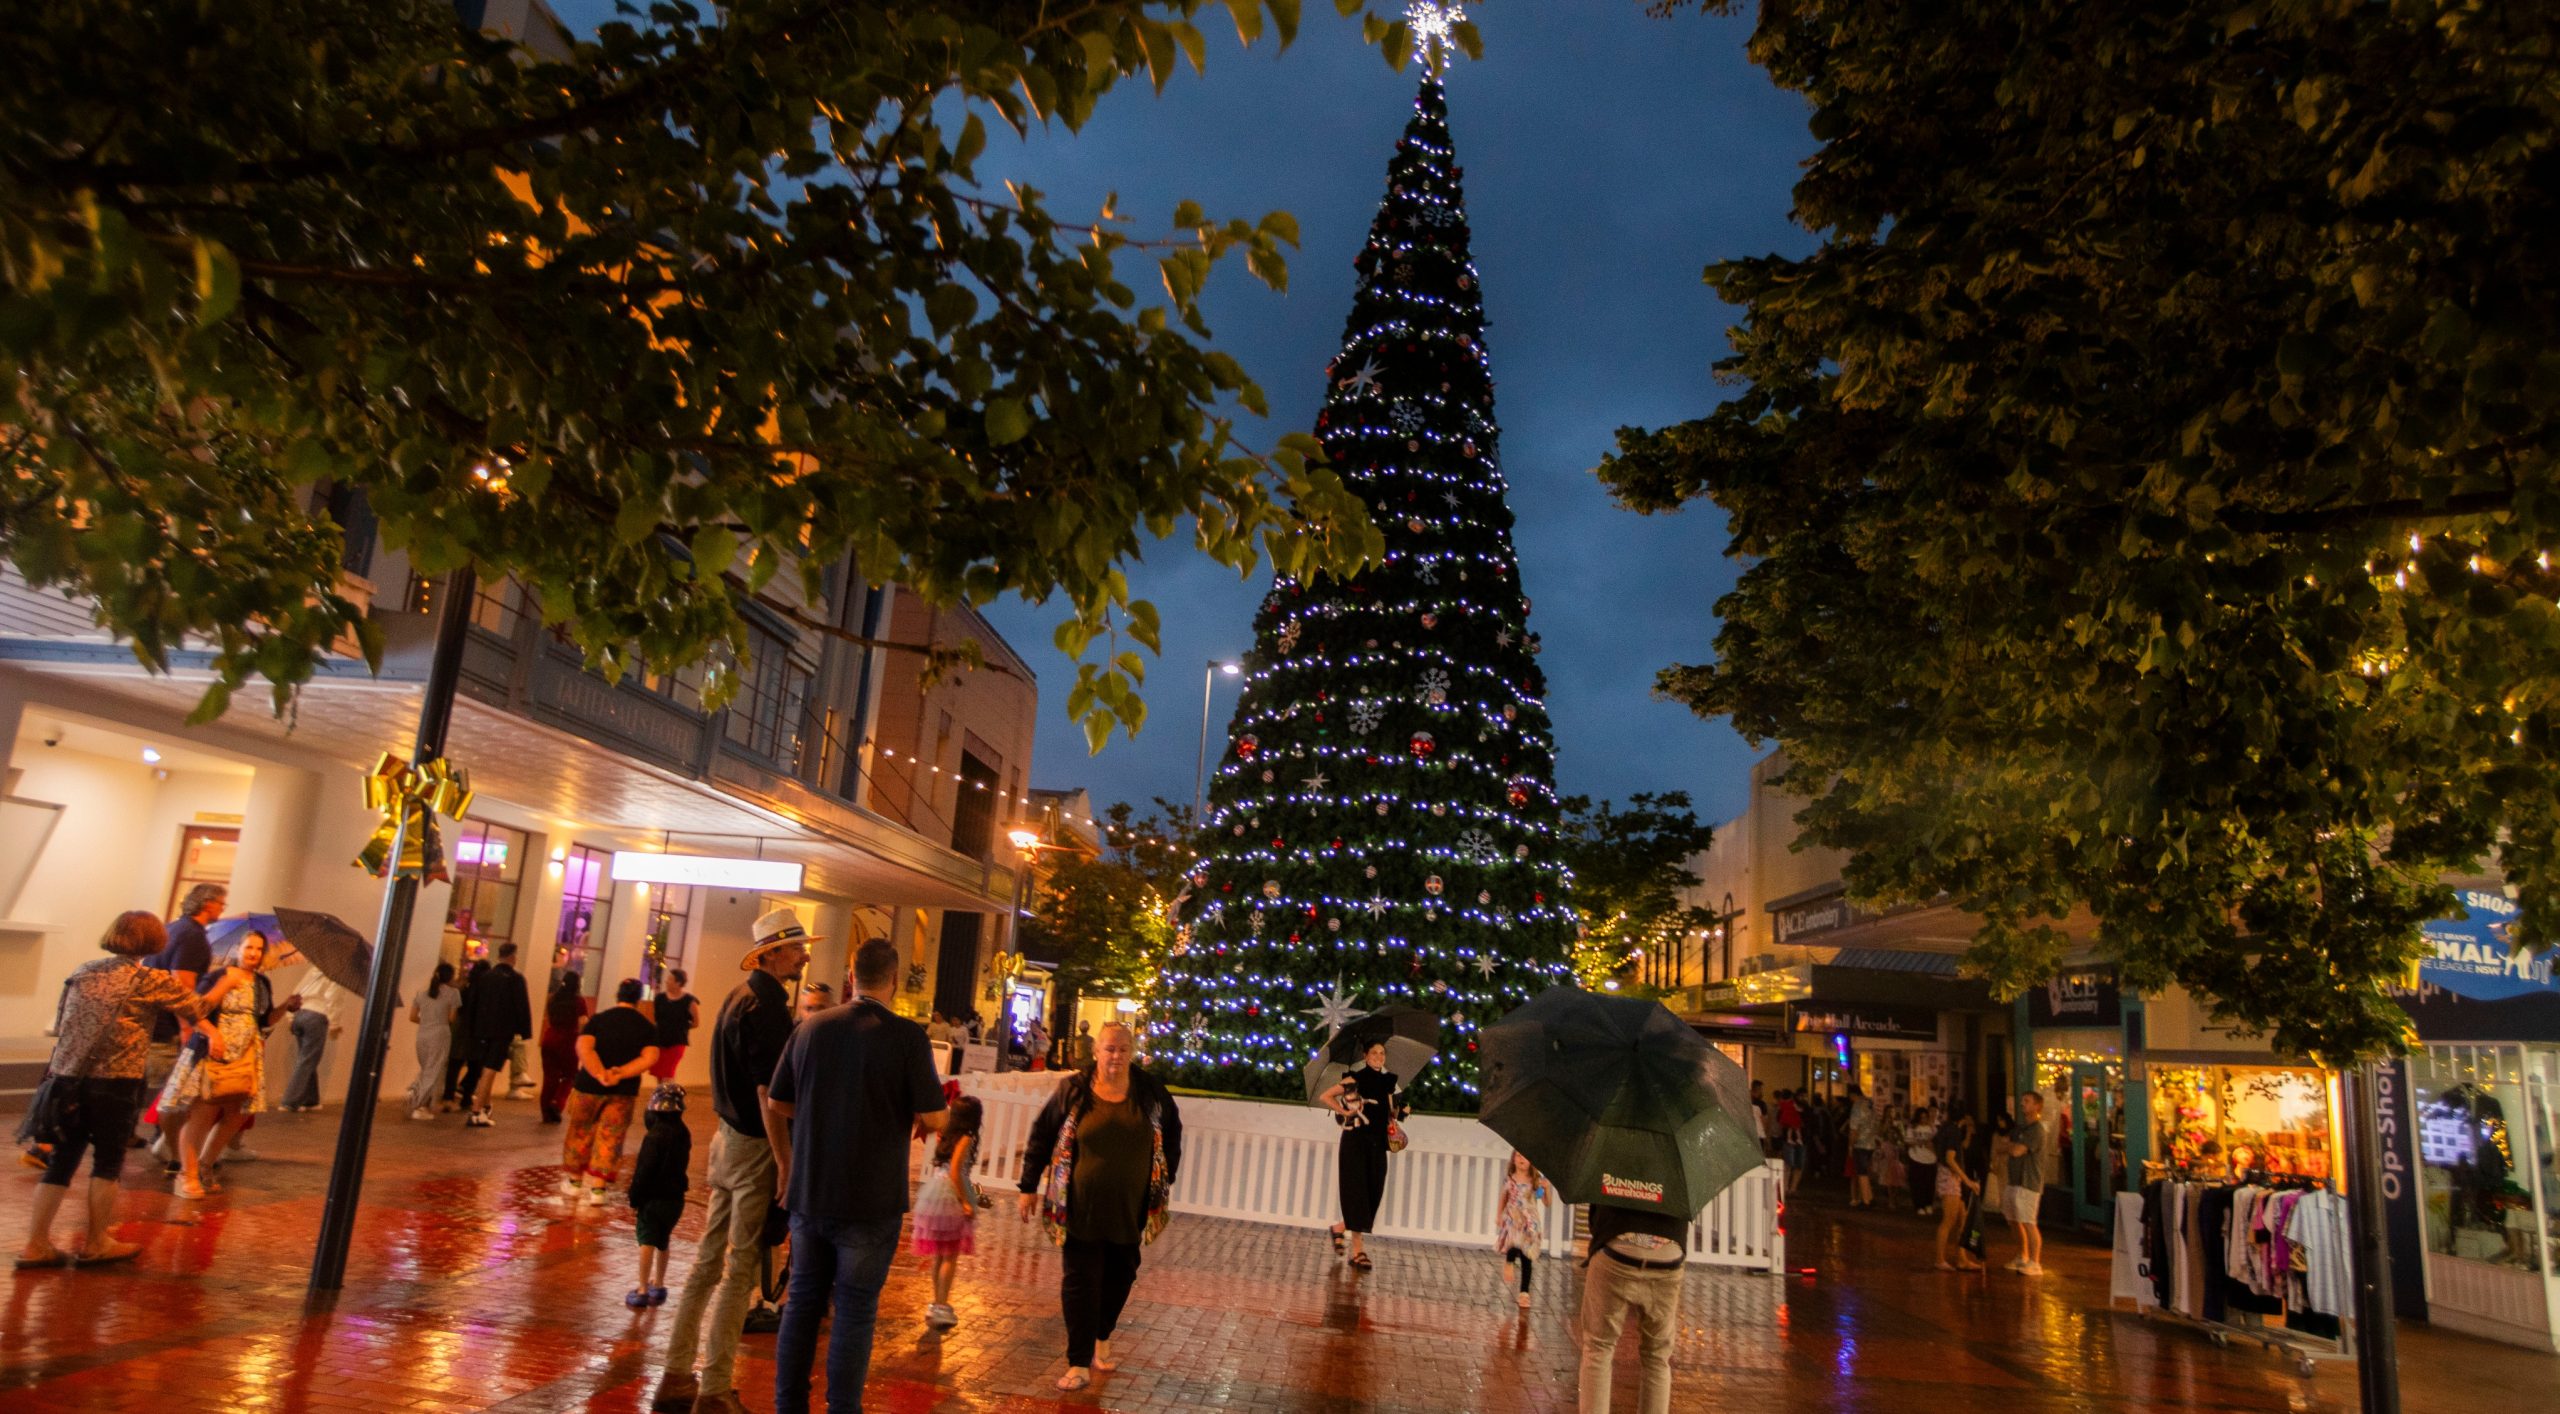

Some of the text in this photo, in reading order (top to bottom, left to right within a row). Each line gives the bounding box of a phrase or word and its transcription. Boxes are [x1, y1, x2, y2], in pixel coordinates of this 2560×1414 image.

[2467, 891, 2515, 915] SHOP
[2443, 932, 2477, 943] BRANCH
[2432, 940, 2501, 966] MAL
[2433, 960, 2474, 974] LEAGUE
[2475, 965, 2501, 976] NSW
[2060, 973, 2097, 998] ACE
[1853, 1014, 1901, 1032] Arcade
[1602, 1173, 1663, 1193] BUNNINGS
[1606, 1186, 1658, 1201] warehouse
